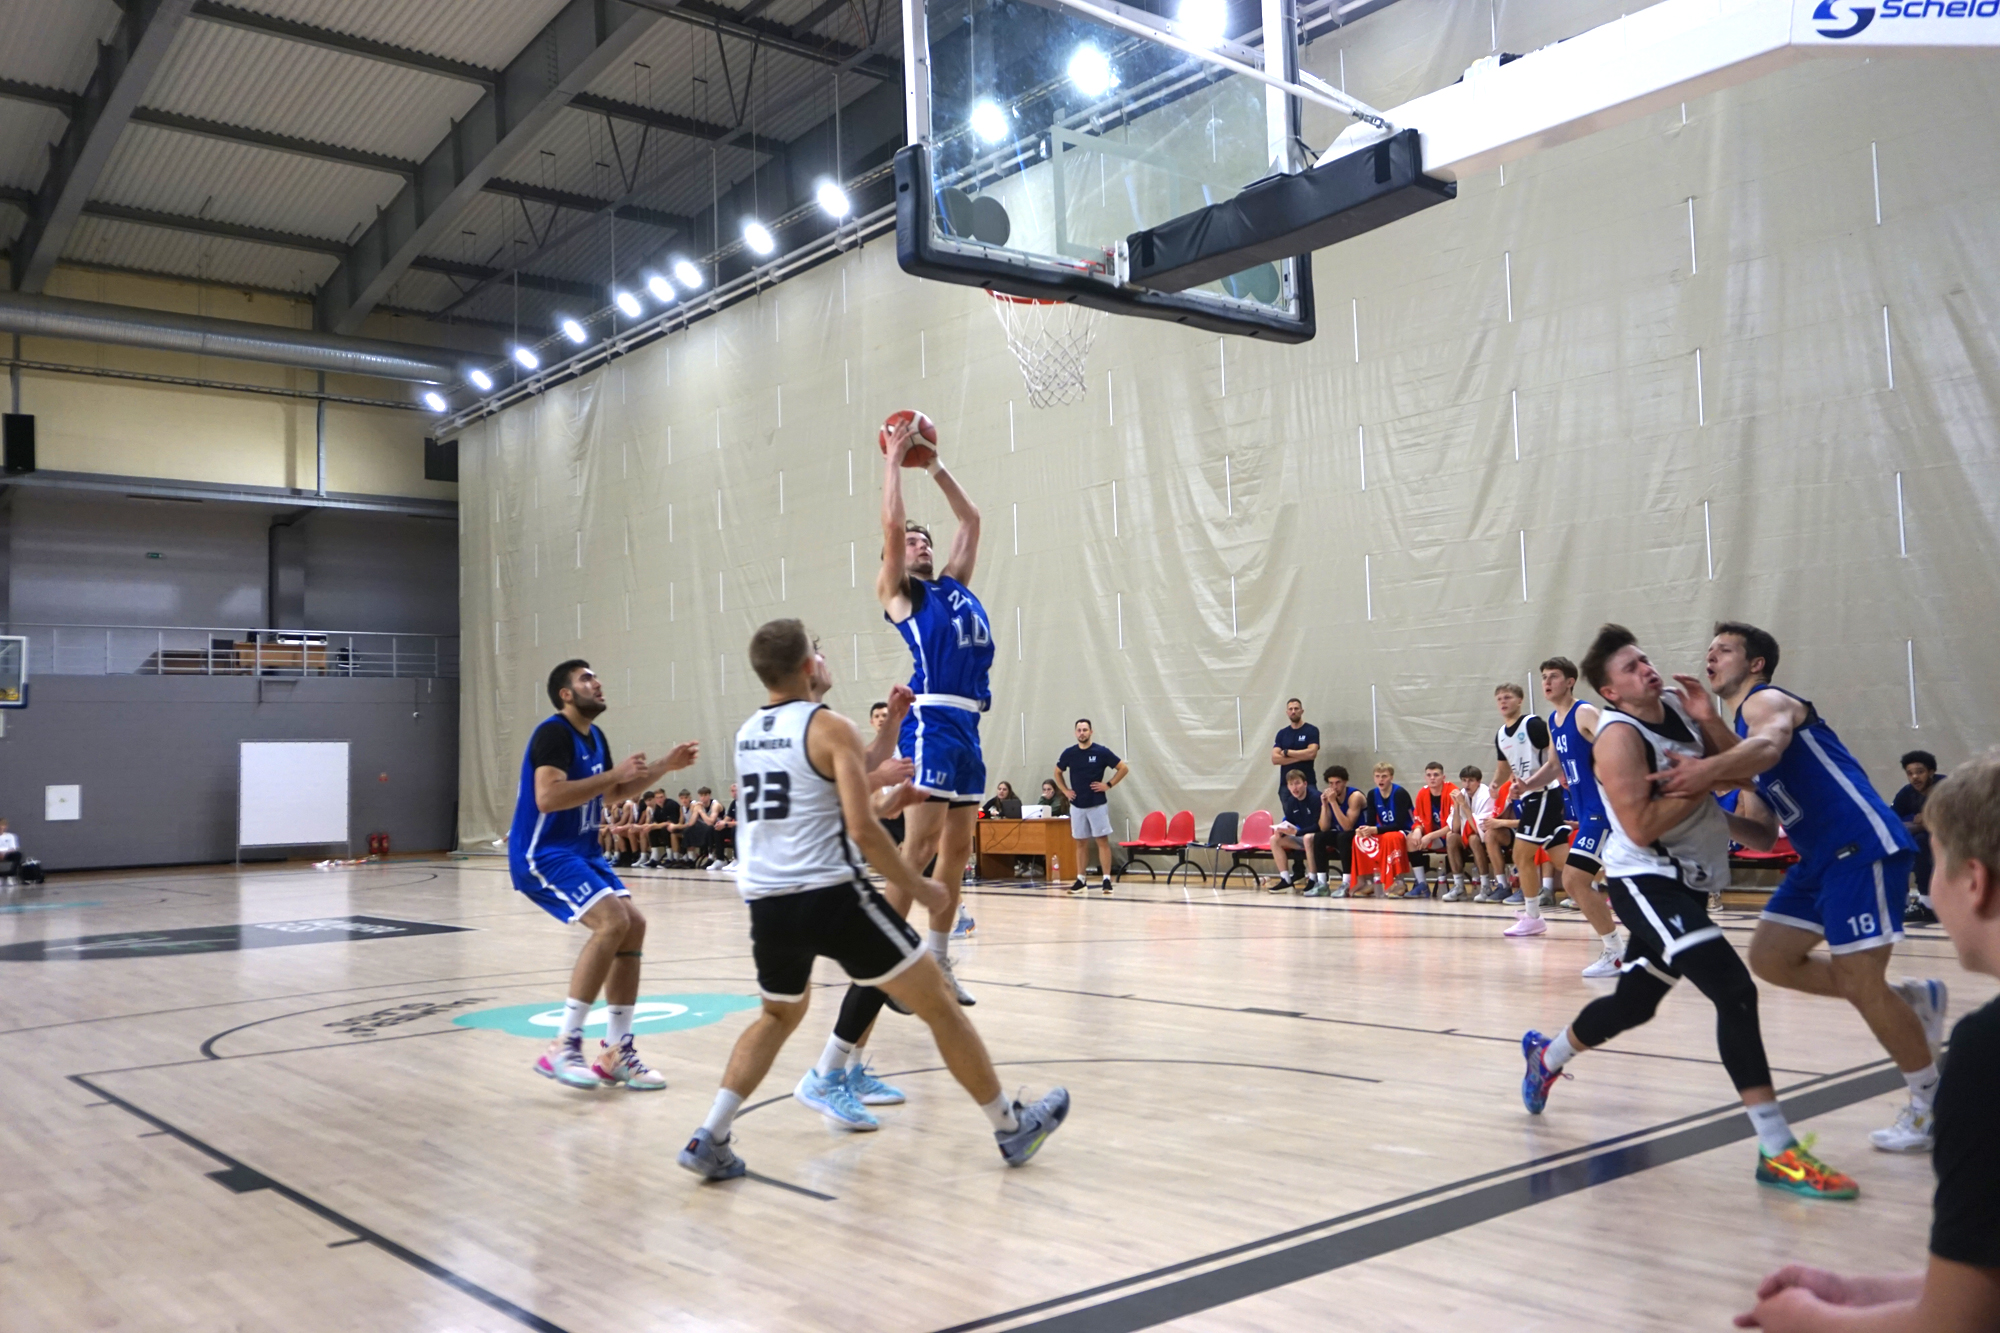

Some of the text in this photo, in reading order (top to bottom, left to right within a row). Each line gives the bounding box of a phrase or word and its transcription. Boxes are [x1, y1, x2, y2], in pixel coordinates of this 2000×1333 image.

[1880, 0, 2000, 18] Scheld
[1556, 734, 1568, 753] 49
[926, 769, 947, 785] LU
[742, 771, 791, 823] 23
[1381, 810, 1395, 823] 28
[1577, 836, 1596, 850] 49
[571, 881, 593, 903] LU
[1847, 912, 1876, 937] 18
